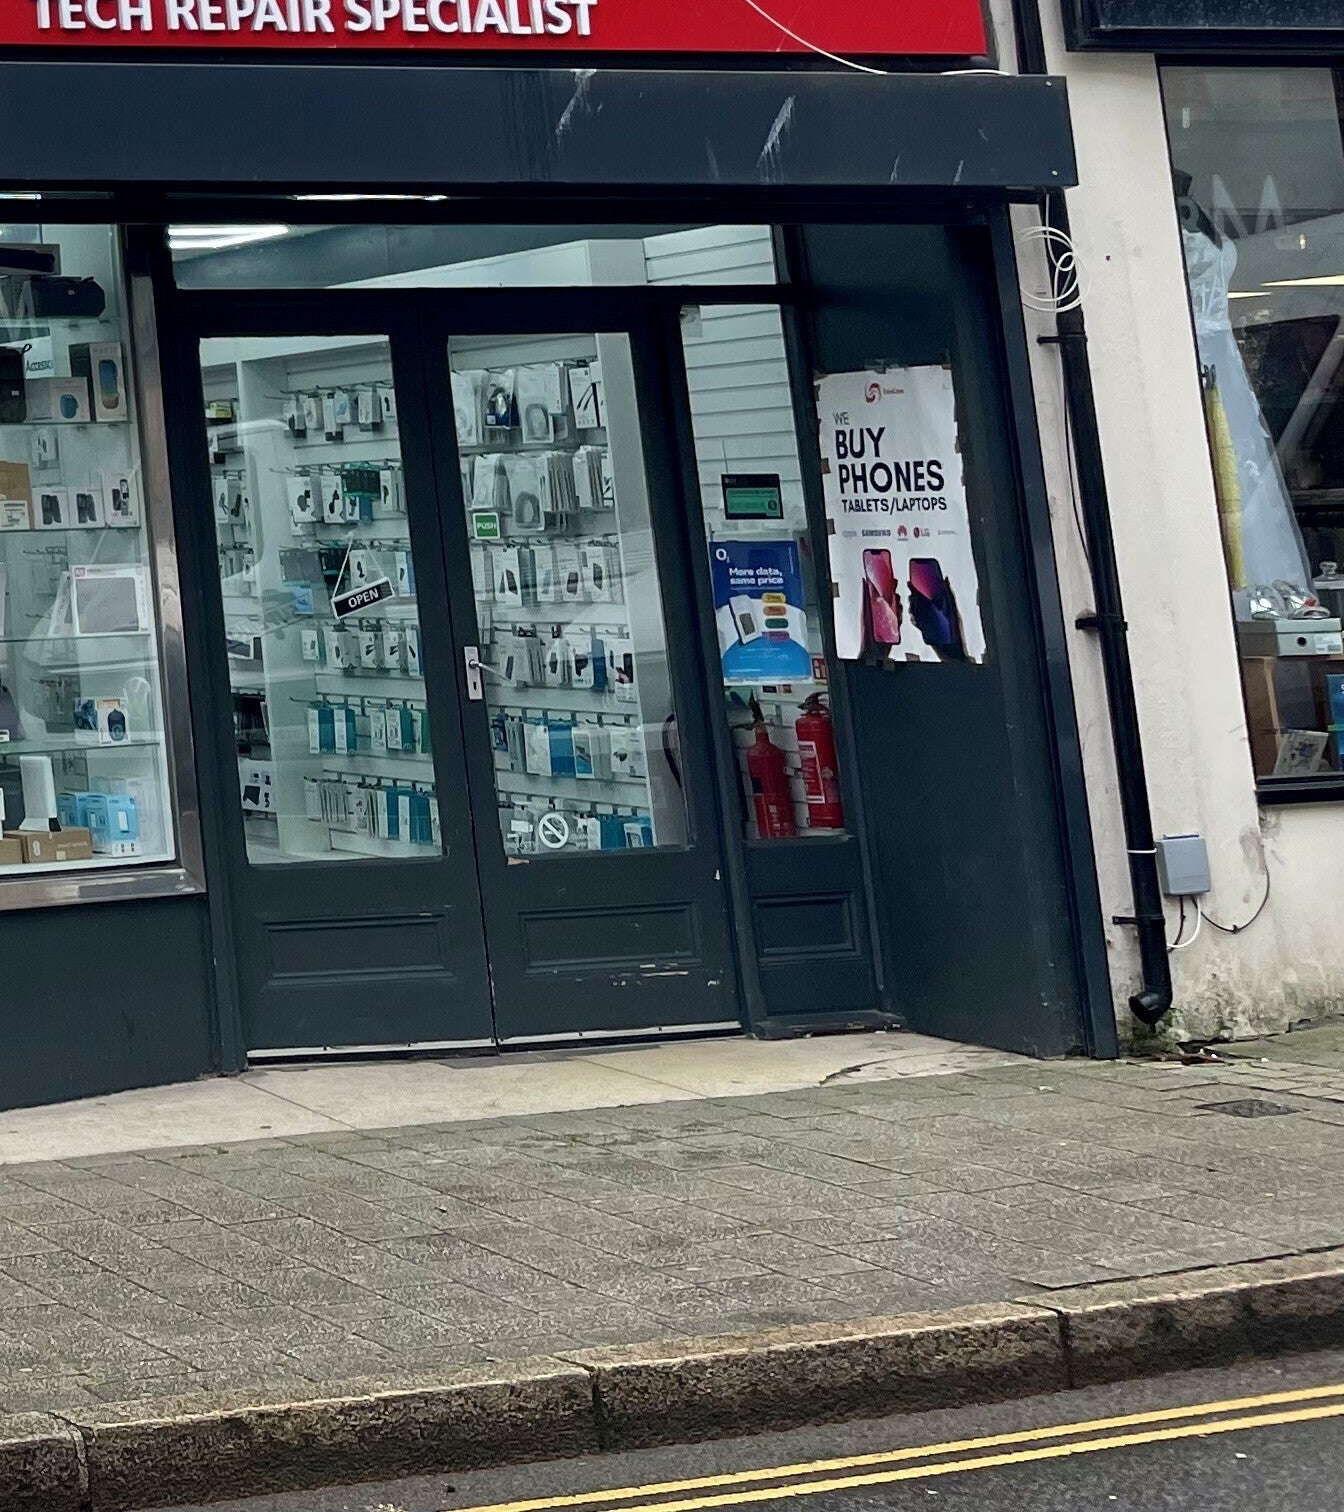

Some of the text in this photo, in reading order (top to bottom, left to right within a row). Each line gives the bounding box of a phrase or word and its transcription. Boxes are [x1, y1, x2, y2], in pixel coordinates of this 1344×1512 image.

[833, 411, 850, 426] WE
[835, 426, 886, 460] BUY
[838, 460, 945, 494] PHONES
[841, 497, 947, 515] TABLETS/LAPTOPS
[729, 567, 783, 576] More data,
[758, 576, 784, 586] price
[348, 587, 379, 608] OPEN
